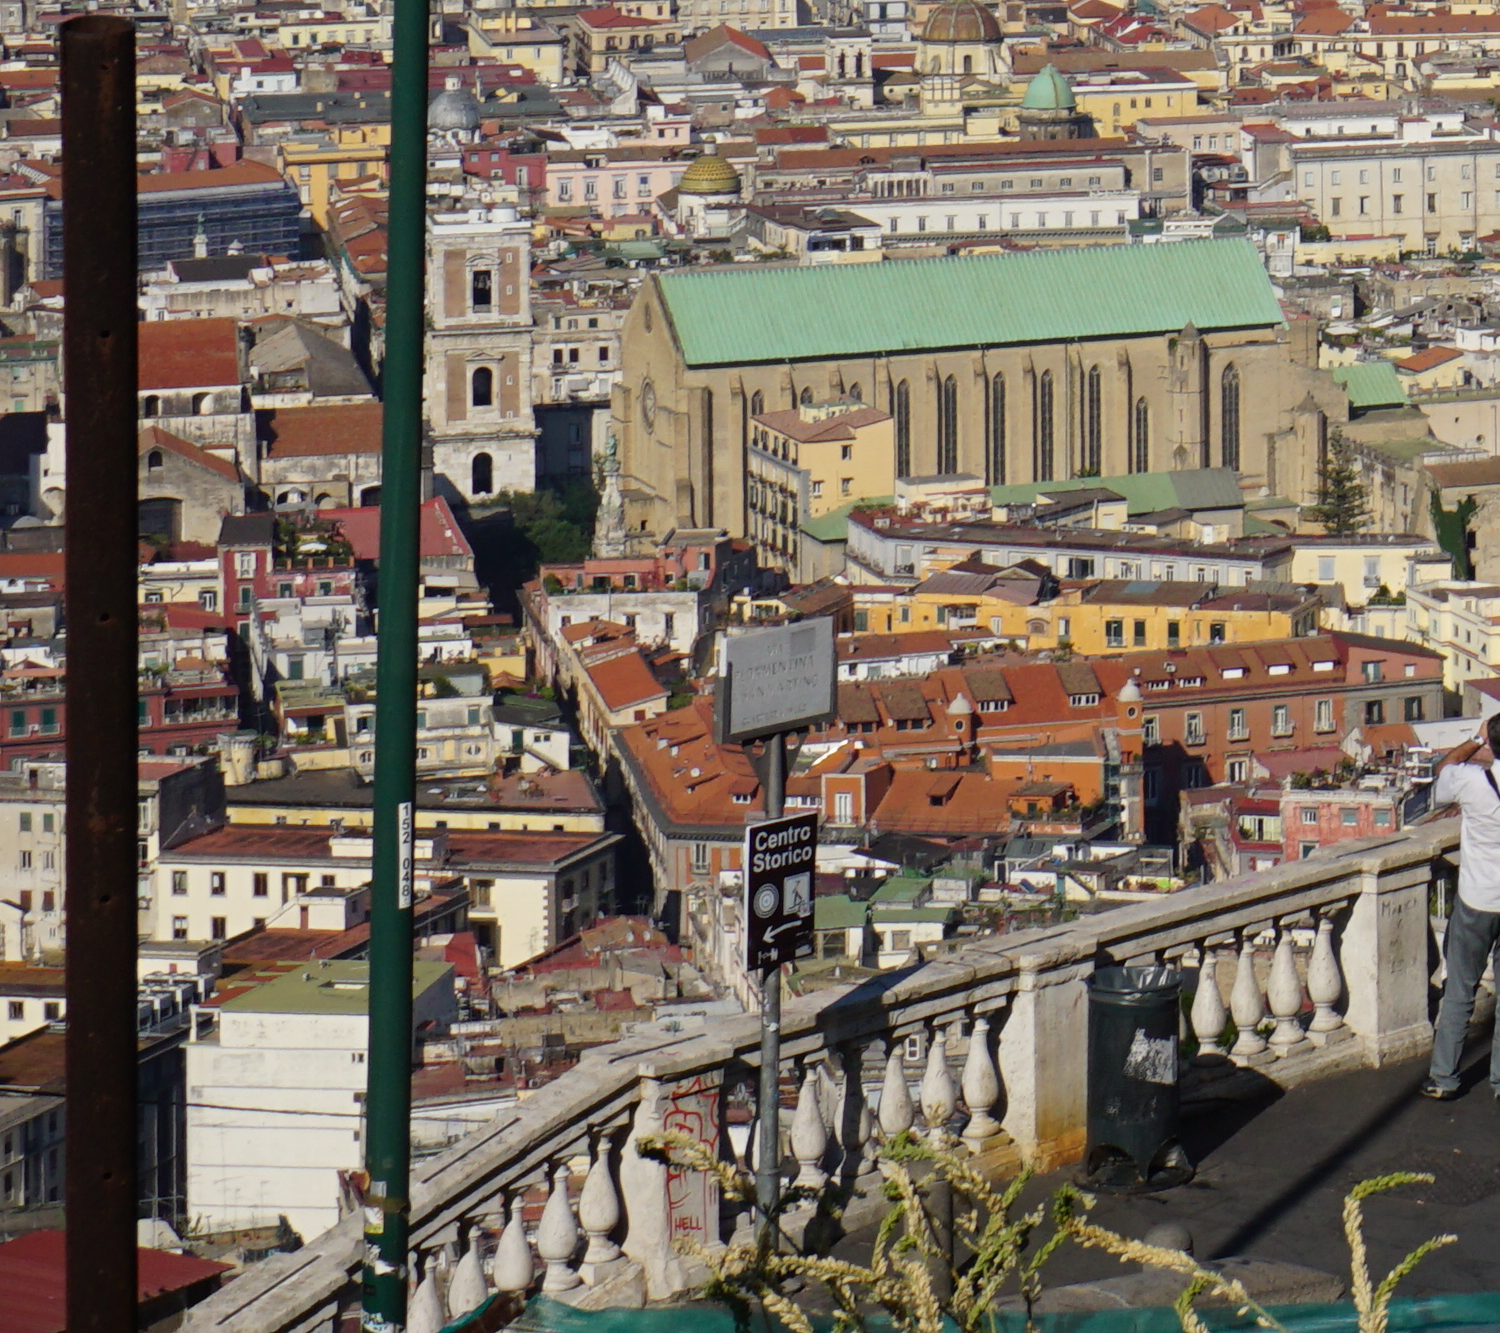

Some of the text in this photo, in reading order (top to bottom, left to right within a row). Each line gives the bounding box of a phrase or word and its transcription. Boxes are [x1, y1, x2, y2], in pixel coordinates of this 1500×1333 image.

[402, 803, 411, 898] 152 048
[754, 822, 812, 852] Centro
[752, 845, 813, 874] Storico
[674, 1215, 703, 1232] HELL
